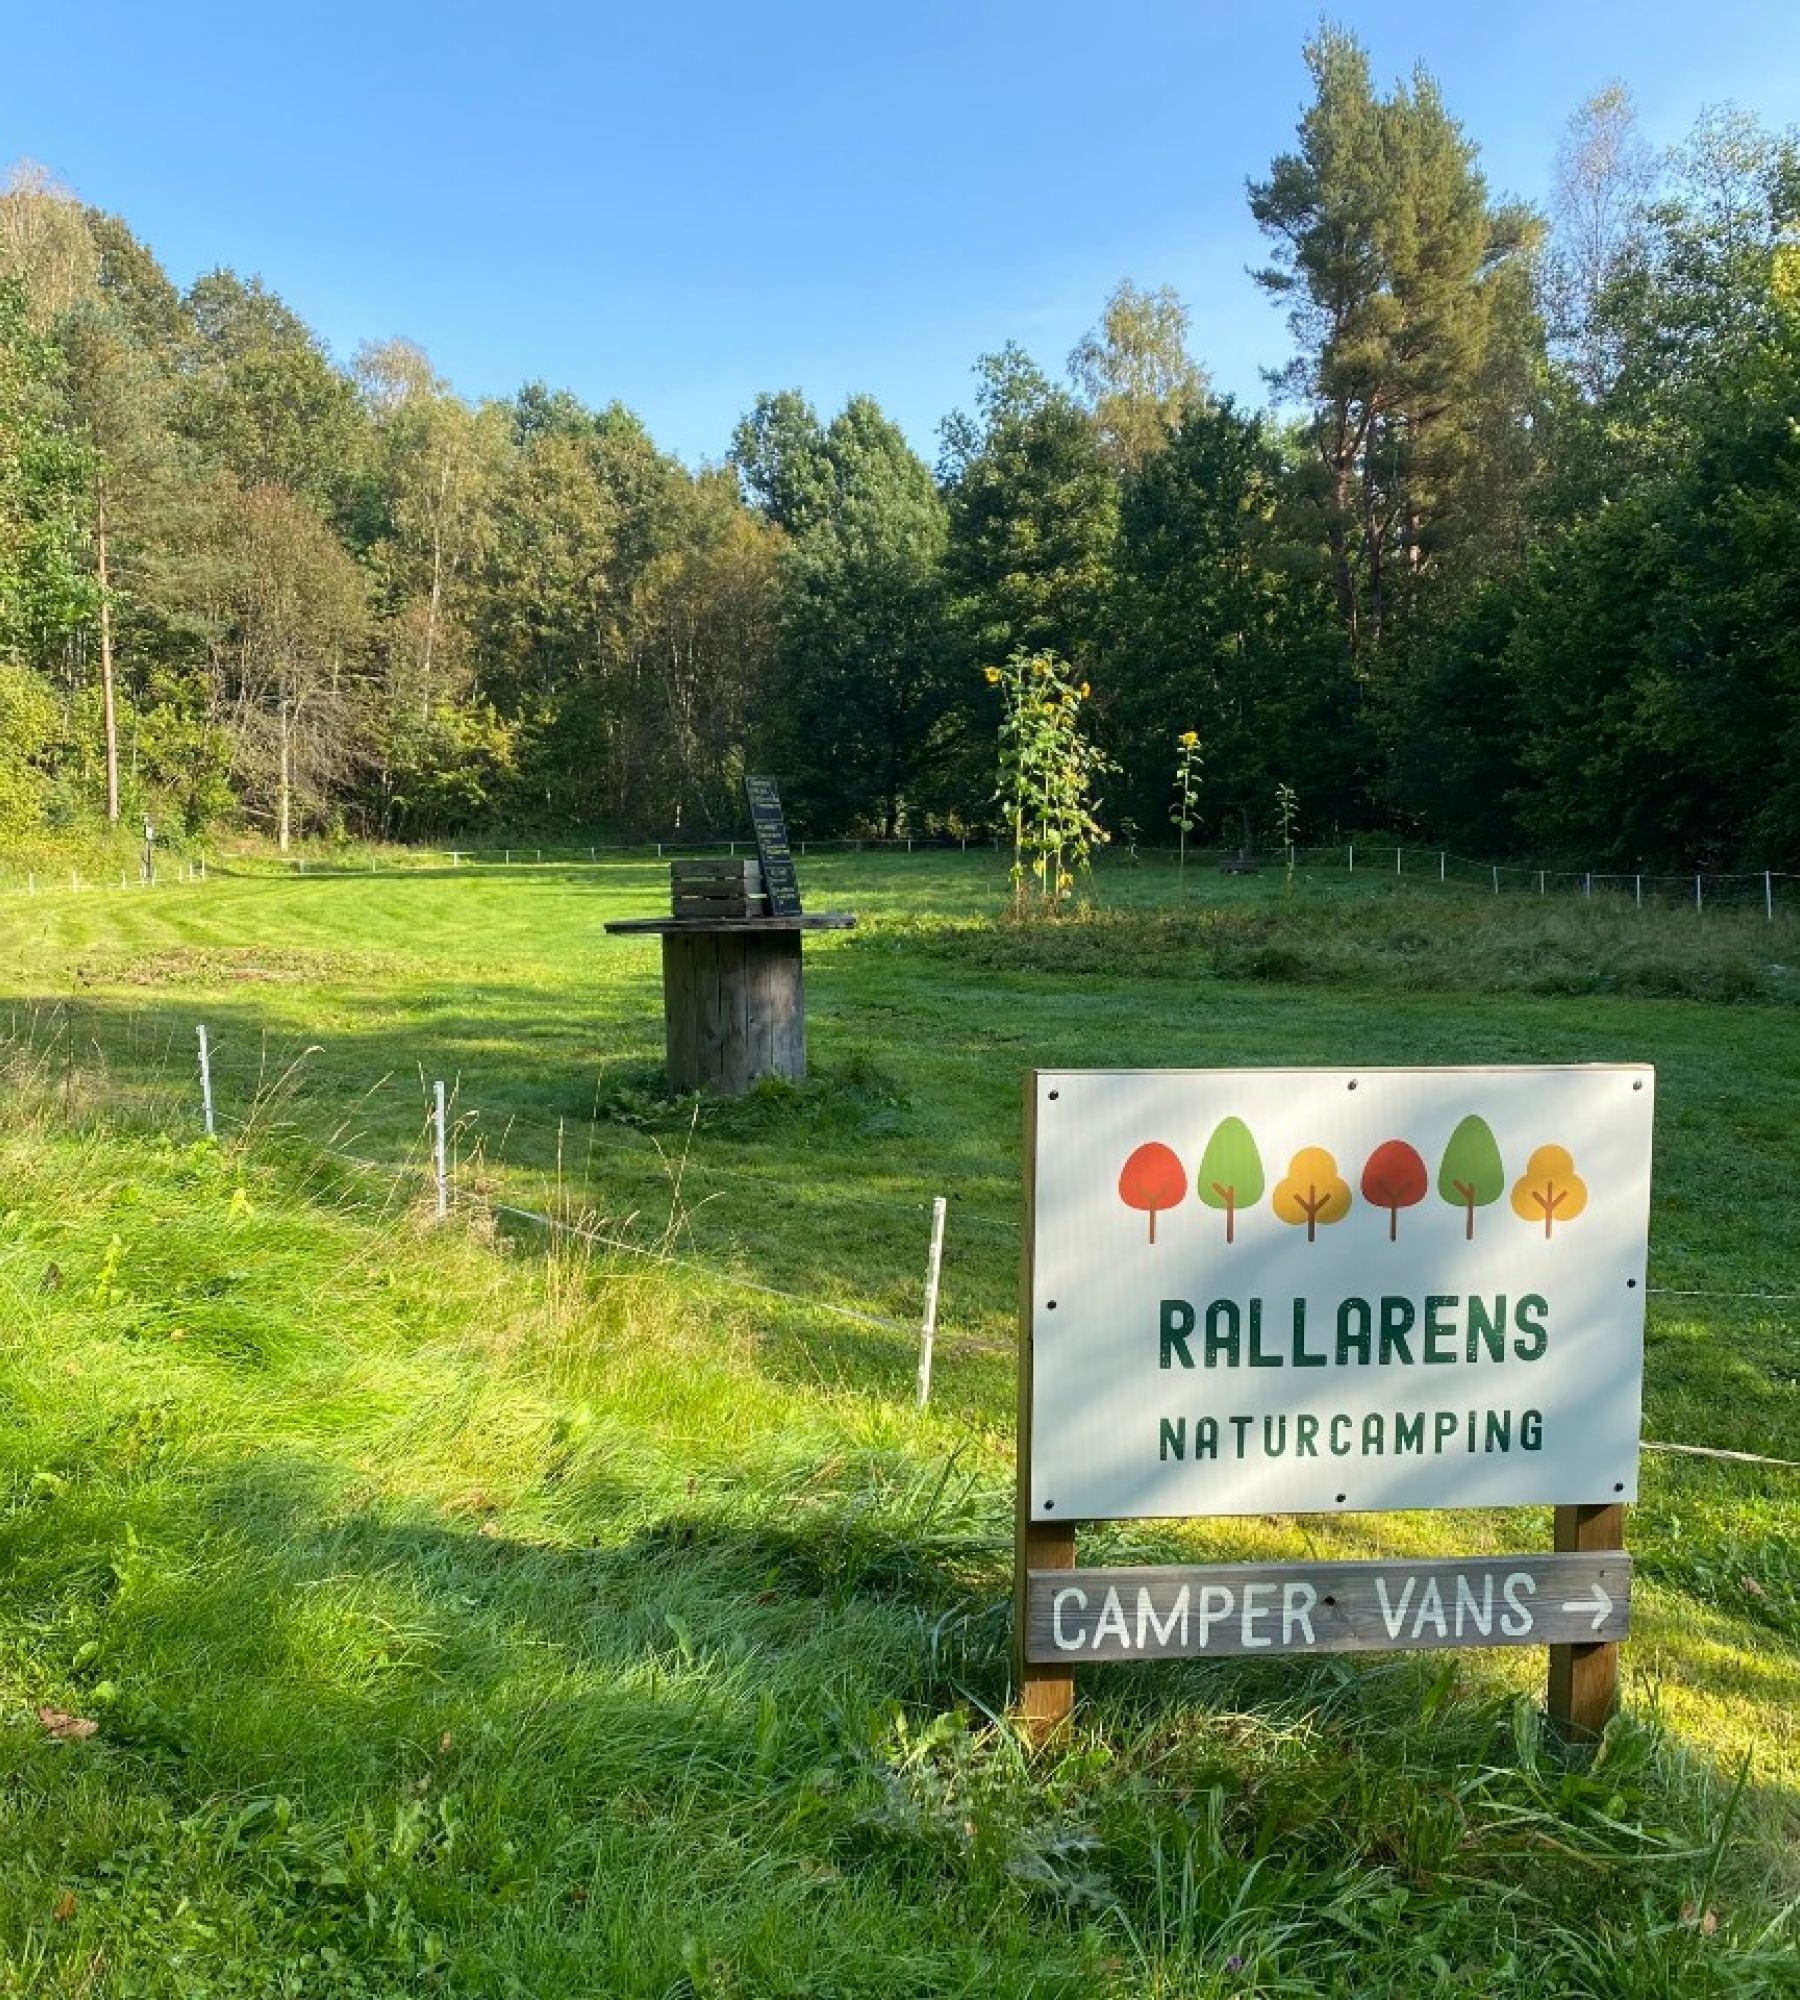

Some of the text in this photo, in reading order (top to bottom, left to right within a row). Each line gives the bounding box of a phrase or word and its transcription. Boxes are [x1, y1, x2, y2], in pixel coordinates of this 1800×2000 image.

[1159, 1294, 1549, 1369] RALLARENS
[1160, 1410, 1543, 1460] NATURCAMPING
[1053, 1573, 1536, 1650] CAMPER VANS
